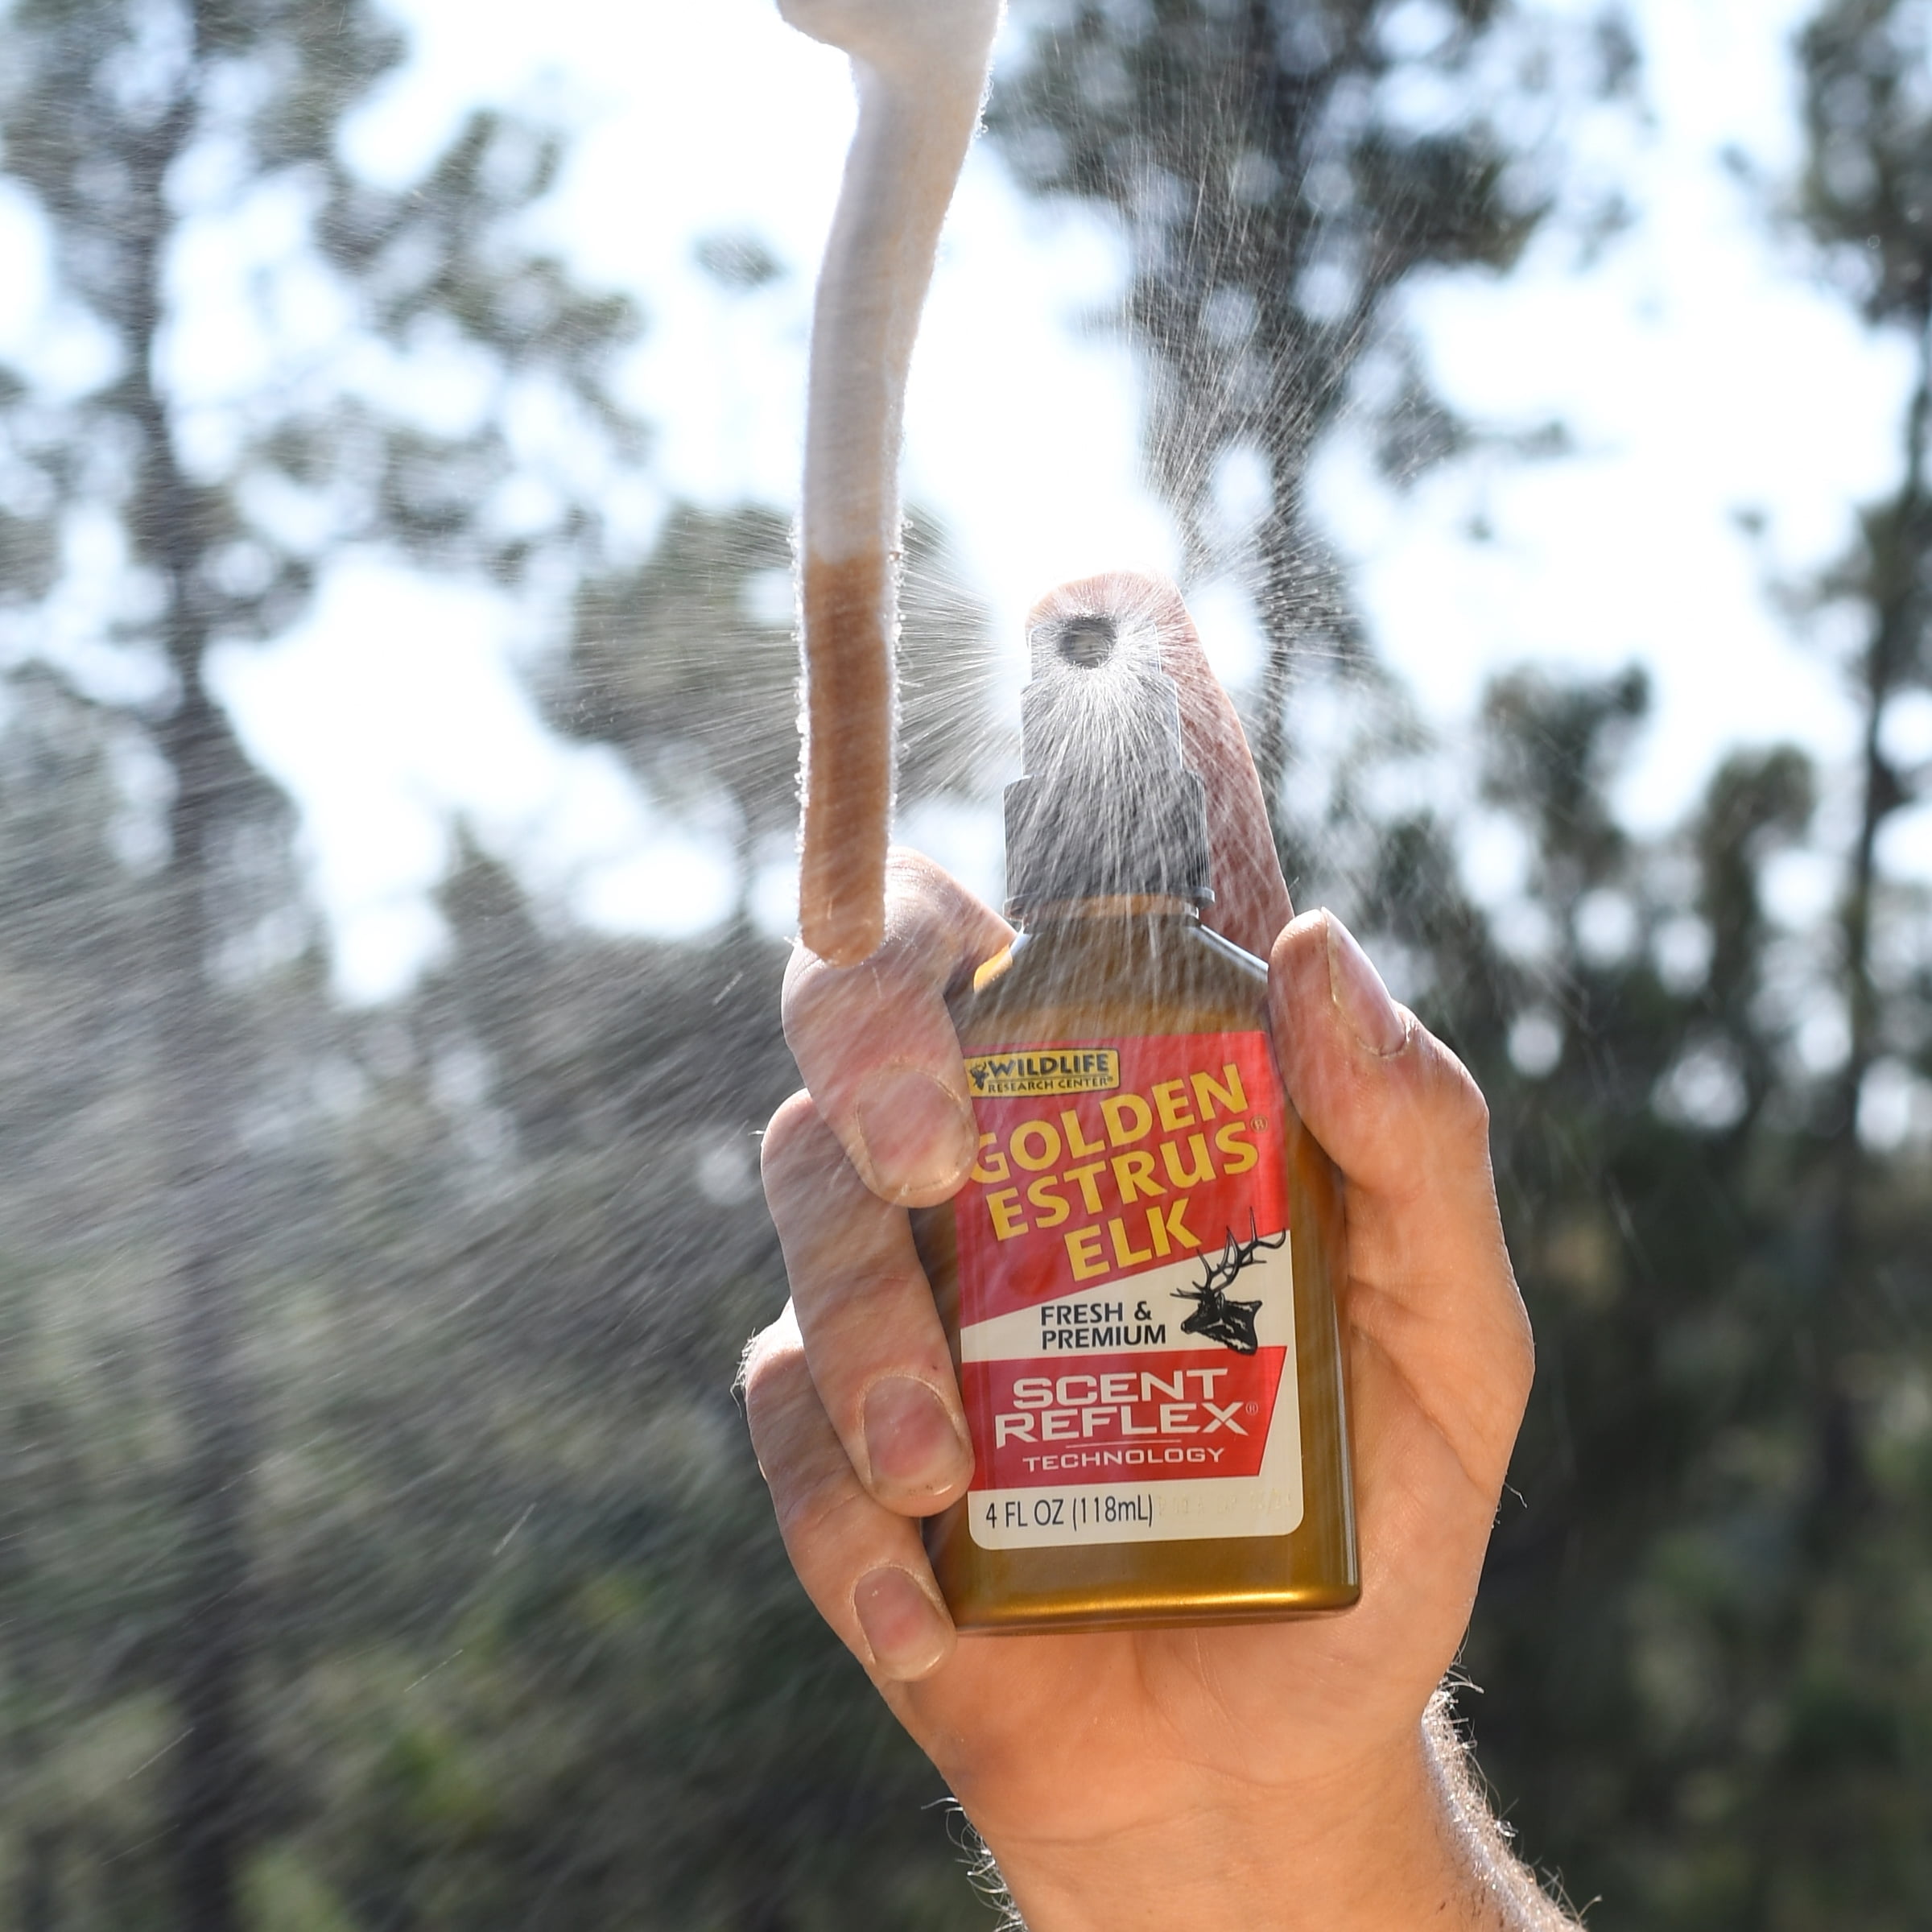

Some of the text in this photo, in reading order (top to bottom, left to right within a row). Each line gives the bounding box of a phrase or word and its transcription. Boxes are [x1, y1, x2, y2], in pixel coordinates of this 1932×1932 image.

[989, 1054, 1108, 1077] WILDLIFE
[988, 1080, 1054, 1094] RESEARCH
[970, 1063, 1249, 1184] GOLDEN
[1064, 1199, 1202, 1282] ELK
[1041, 1301, 1152, 1326] FRESH &
[1042, 1324, 1166, 1350] PREMIUM
[1012, 1368, 1228, 1410] SCENT
[1022, 1447, 1224, 1472] TECHNOLOGY
[985, 1503, 997, 1528] 4
[1005, 1501, 1028, 1526] FL
[1034, 1500, 1064, 1525] OZ
[1072, 1494, 1153, 1531] (118mL)
